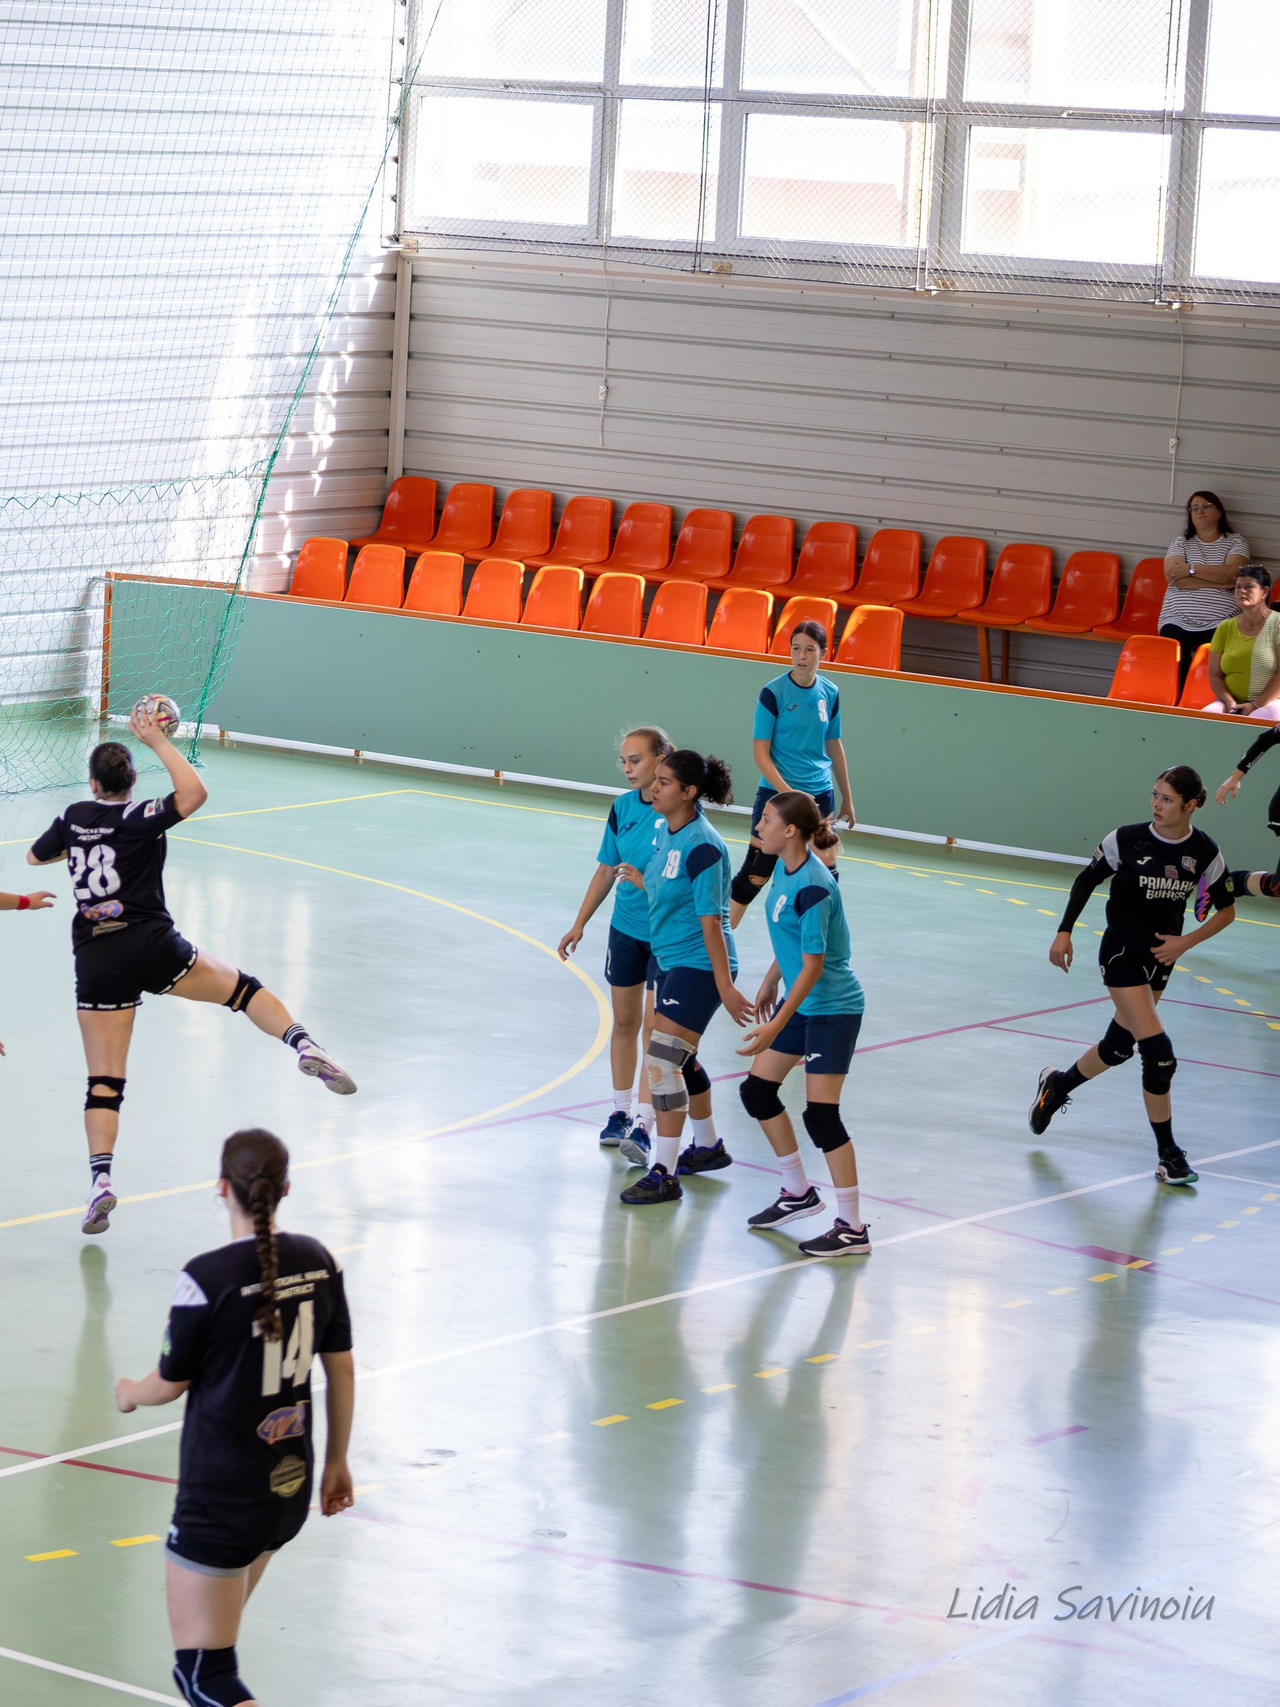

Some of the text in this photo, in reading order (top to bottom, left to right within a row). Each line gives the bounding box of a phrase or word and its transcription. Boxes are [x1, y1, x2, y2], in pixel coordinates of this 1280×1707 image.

[68, 844, 121, 900] 28
[661, 849, 681, 879] 19
[252, 1300, 315, 1397] 14
